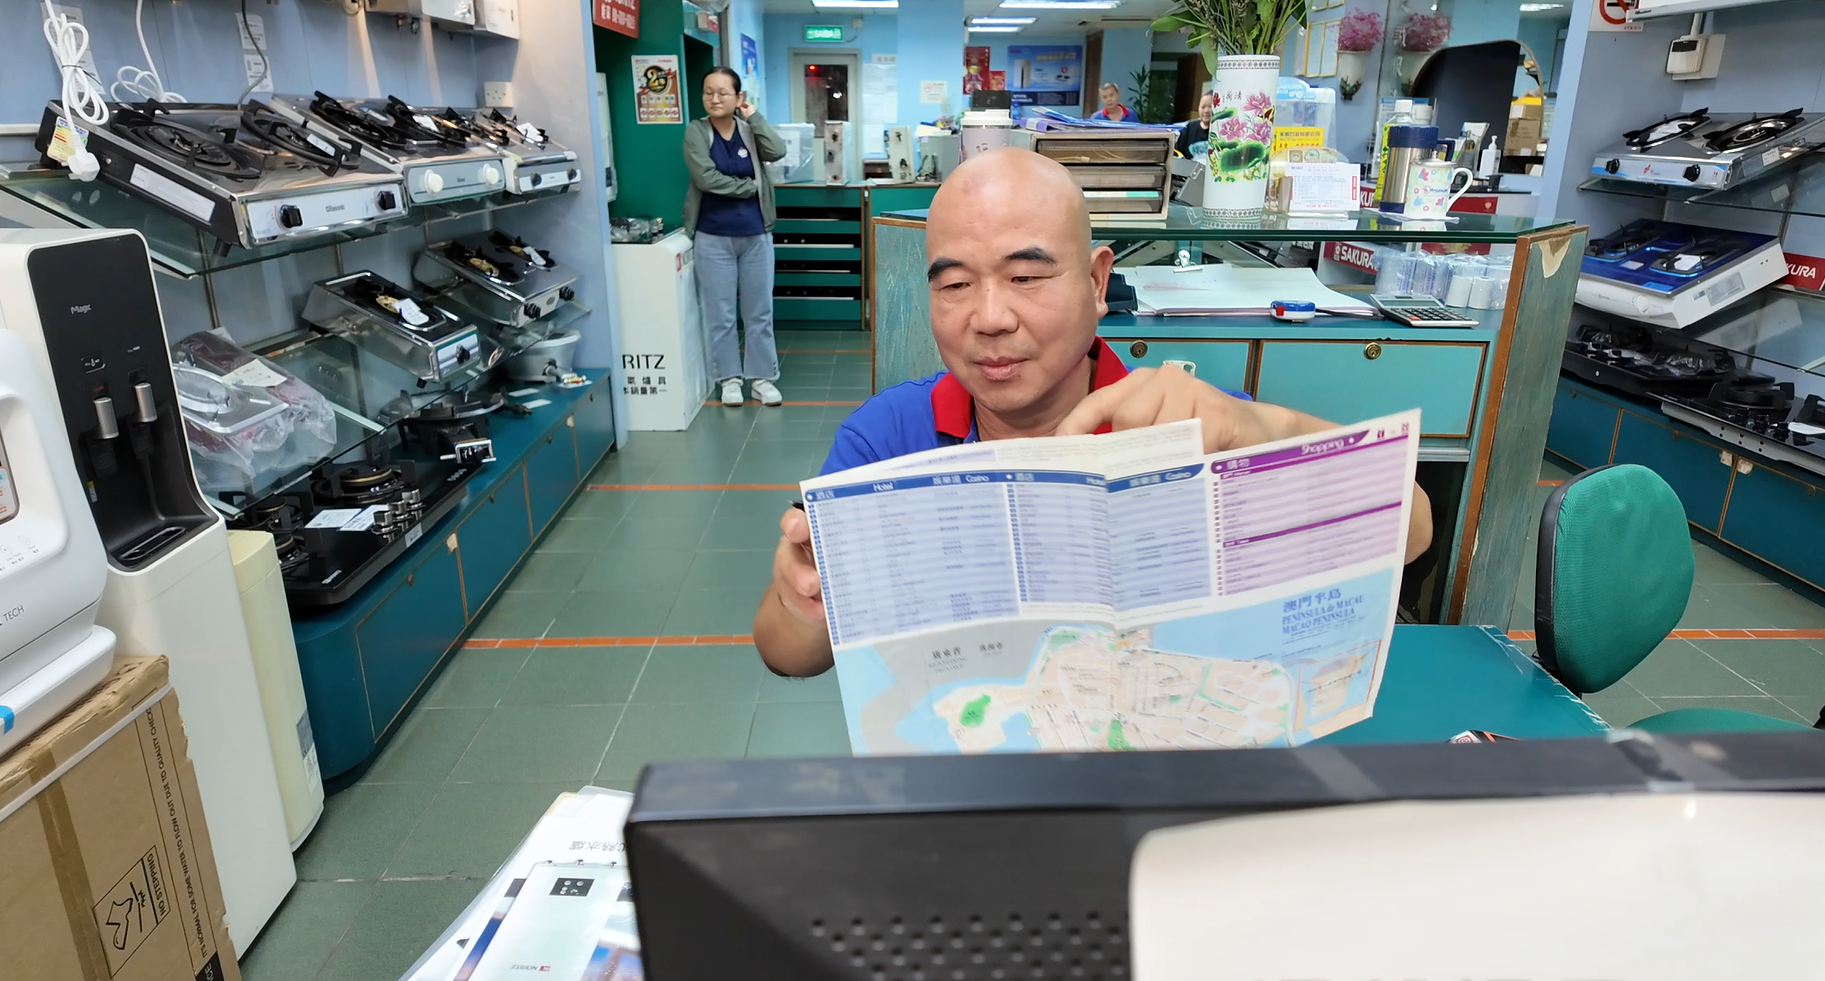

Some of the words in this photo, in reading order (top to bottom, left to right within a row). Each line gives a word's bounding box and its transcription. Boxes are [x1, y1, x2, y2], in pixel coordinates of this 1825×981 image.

[1341, 246, 1374, 270] SAKURA
[622, 354, 666, 370] RITZ
[1301, 438, 1344, 455] Shopping
[3, 604, 24, 622] TECH
[152, 737, 164, 770] QUALITY
[160, 770, 168, 783] TO
[163, 782, 172, 800] DUE
[168, 800, 176, 816] OUT
[172, 817, 181, 840] FLOW
[176, 839, 184, 852] TO
[180, 850, 190, 877] WATER
[147, 853, 163, 900] STEPPING
[184, 876, 194, 898] SOME
[158, 900, 166, 916] NO
[190, 896, 198, 914] FOR
[194, 912, 204, 946] NORMAL
